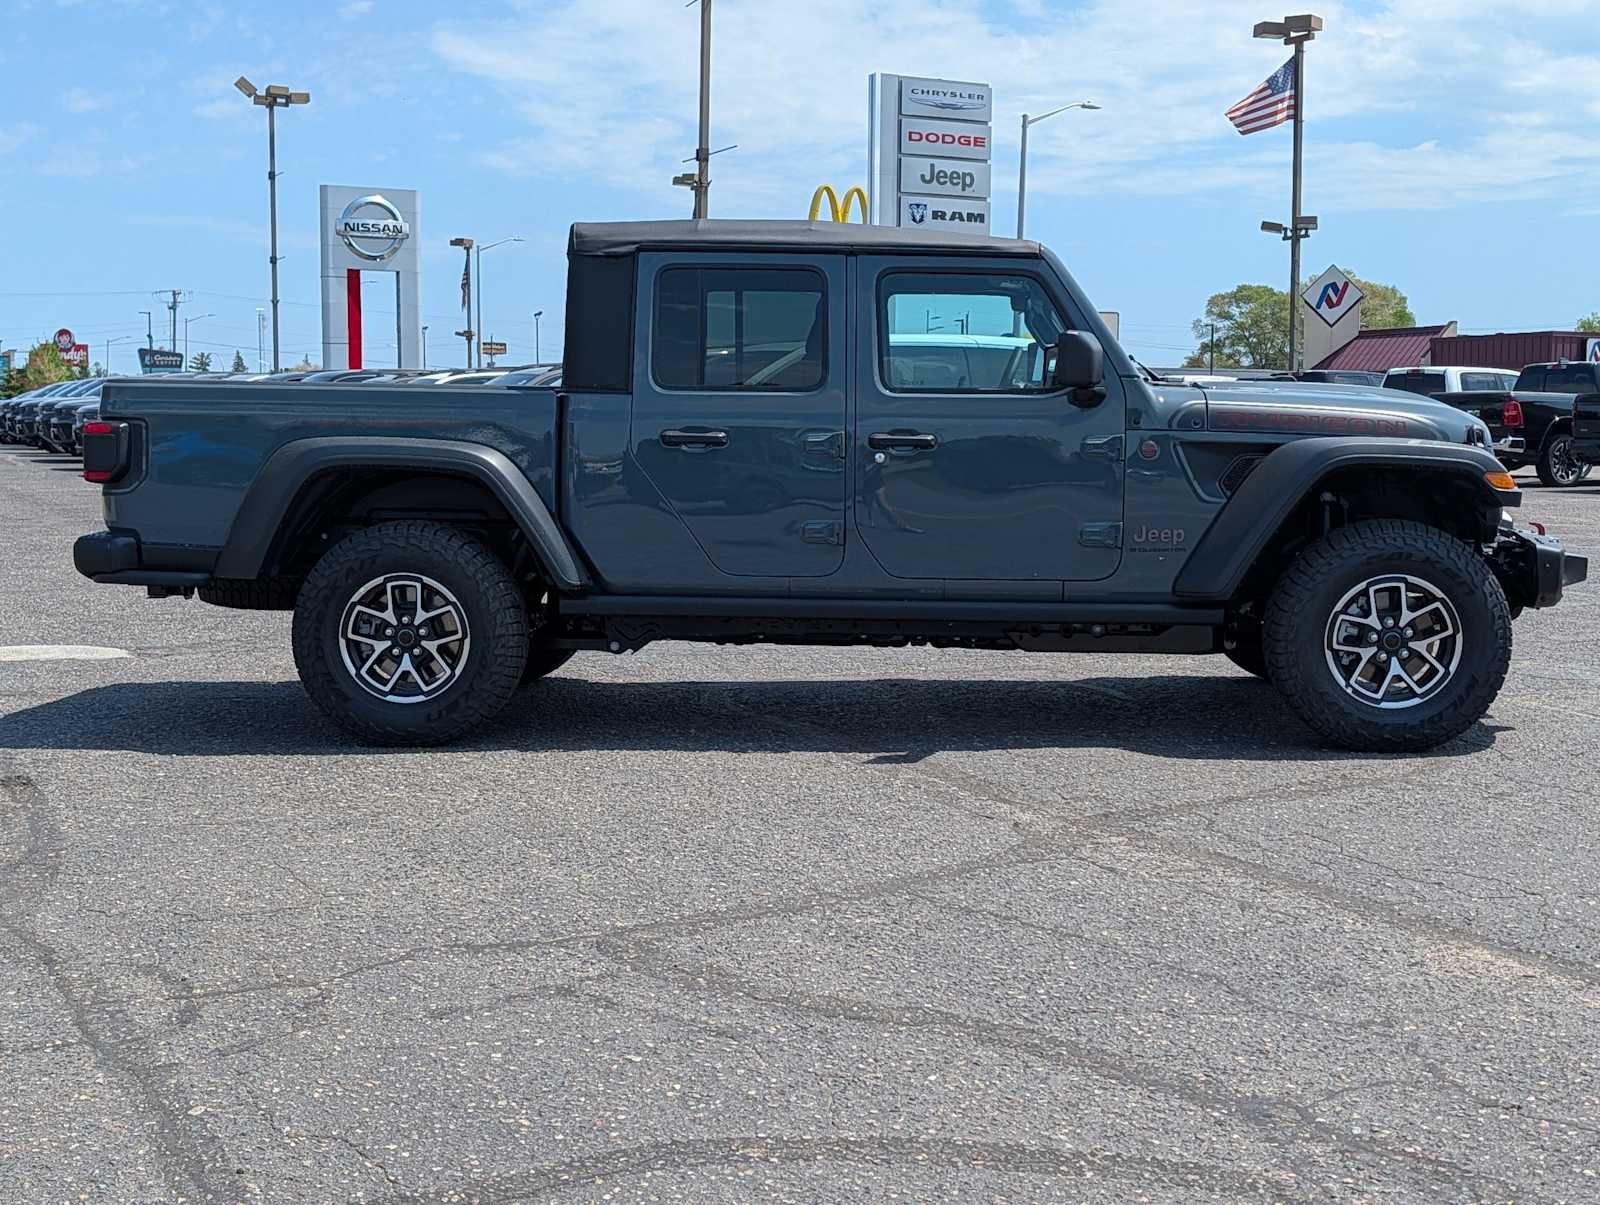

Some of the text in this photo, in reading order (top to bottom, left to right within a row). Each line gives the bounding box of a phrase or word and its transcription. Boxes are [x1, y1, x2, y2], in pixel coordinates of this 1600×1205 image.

[911, 88, 985, 101] CHRYSLER
[908, 131, 986, 147] DODGE
[920, 163, 975, 191] Jeep
[931, 210, 985, 223] RAM
[344, 222, 403, 234] NISSAN
[1215, 411, 1408, 435] RUBICON
[1133, 525, 1185, 545] Jeep
